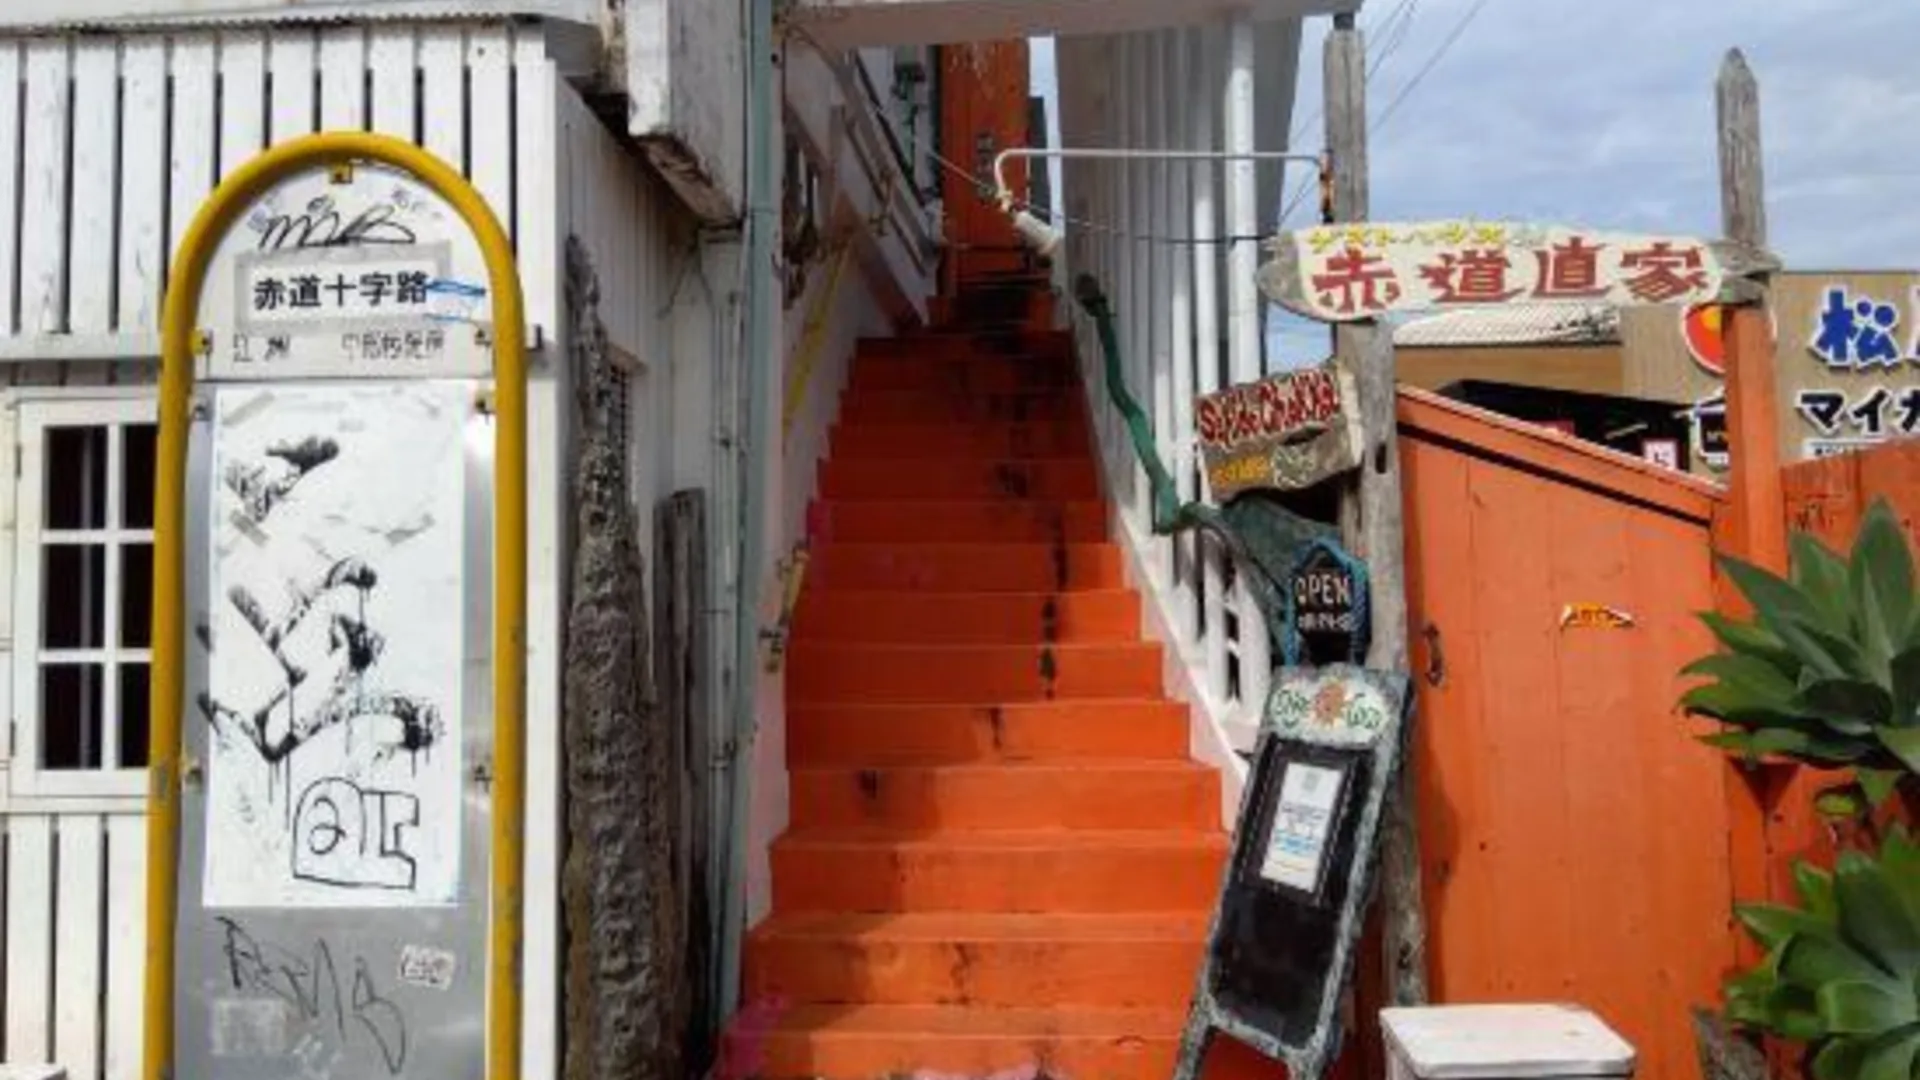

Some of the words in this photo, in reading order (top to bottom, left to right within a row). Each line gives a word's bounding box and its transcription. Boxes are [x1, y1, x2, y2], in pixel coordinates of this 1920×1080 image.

[254, 270, 429, 311] 赤道十字路
[1311, 236, 1708, 313] 赤道直家
[1813, 289, 1920, 362] 松
[1294, 573, 1352, 606] OPEN
